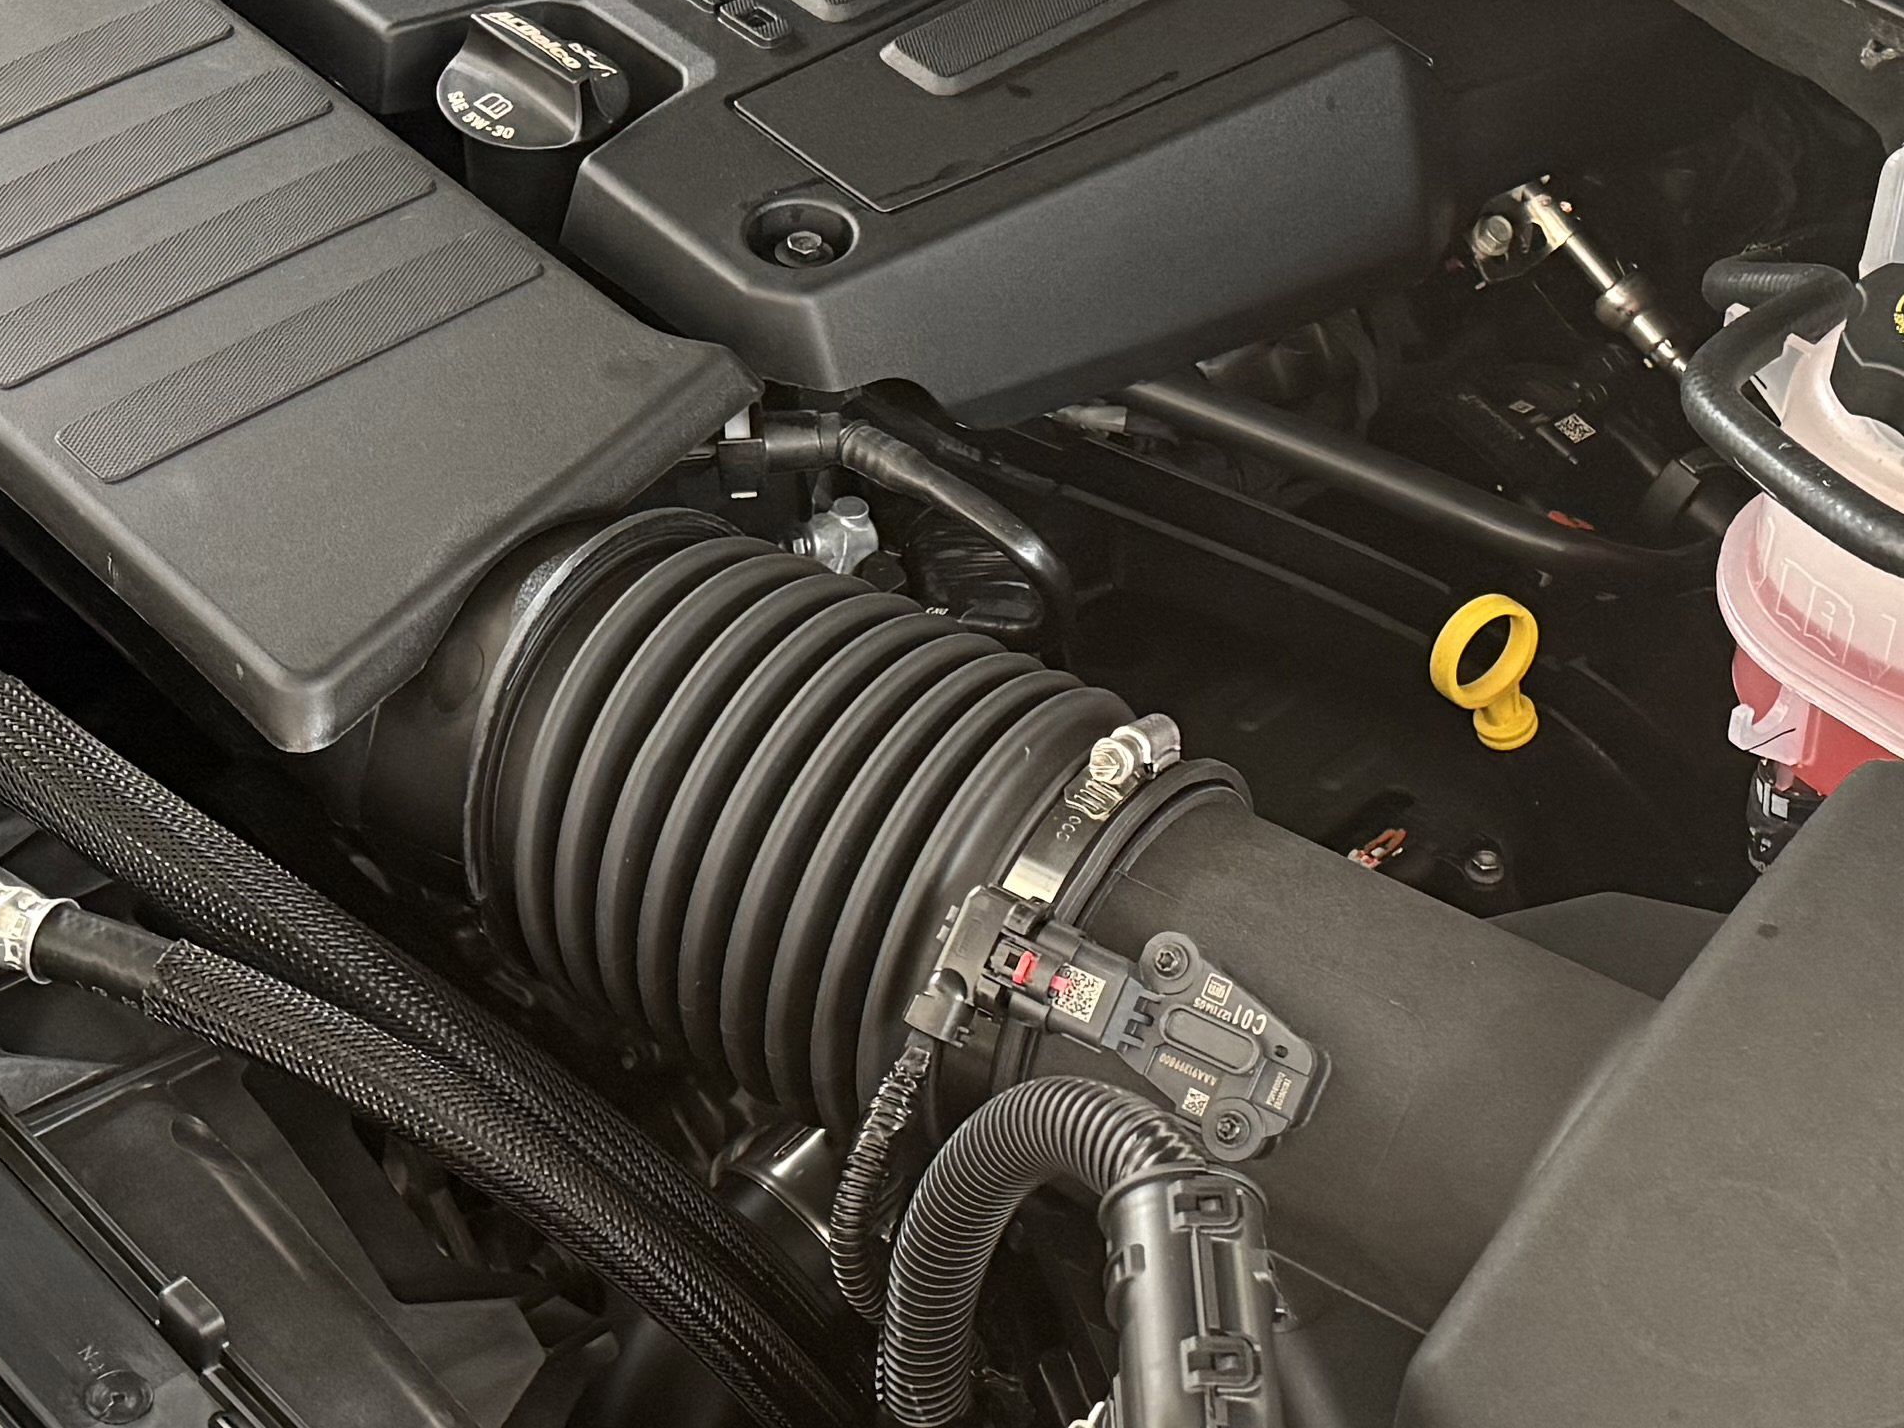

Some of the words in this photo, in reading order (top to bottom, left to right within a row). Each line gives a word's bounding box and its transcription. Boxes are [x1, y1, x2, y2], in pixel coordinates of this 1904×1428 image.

[489, 8, 582, 71] ACDelco
[447, 91, 469, 112] SAE
[462, 111, 514, 139] 5W-30
[1230, 1003, 1269, 1036] C01
